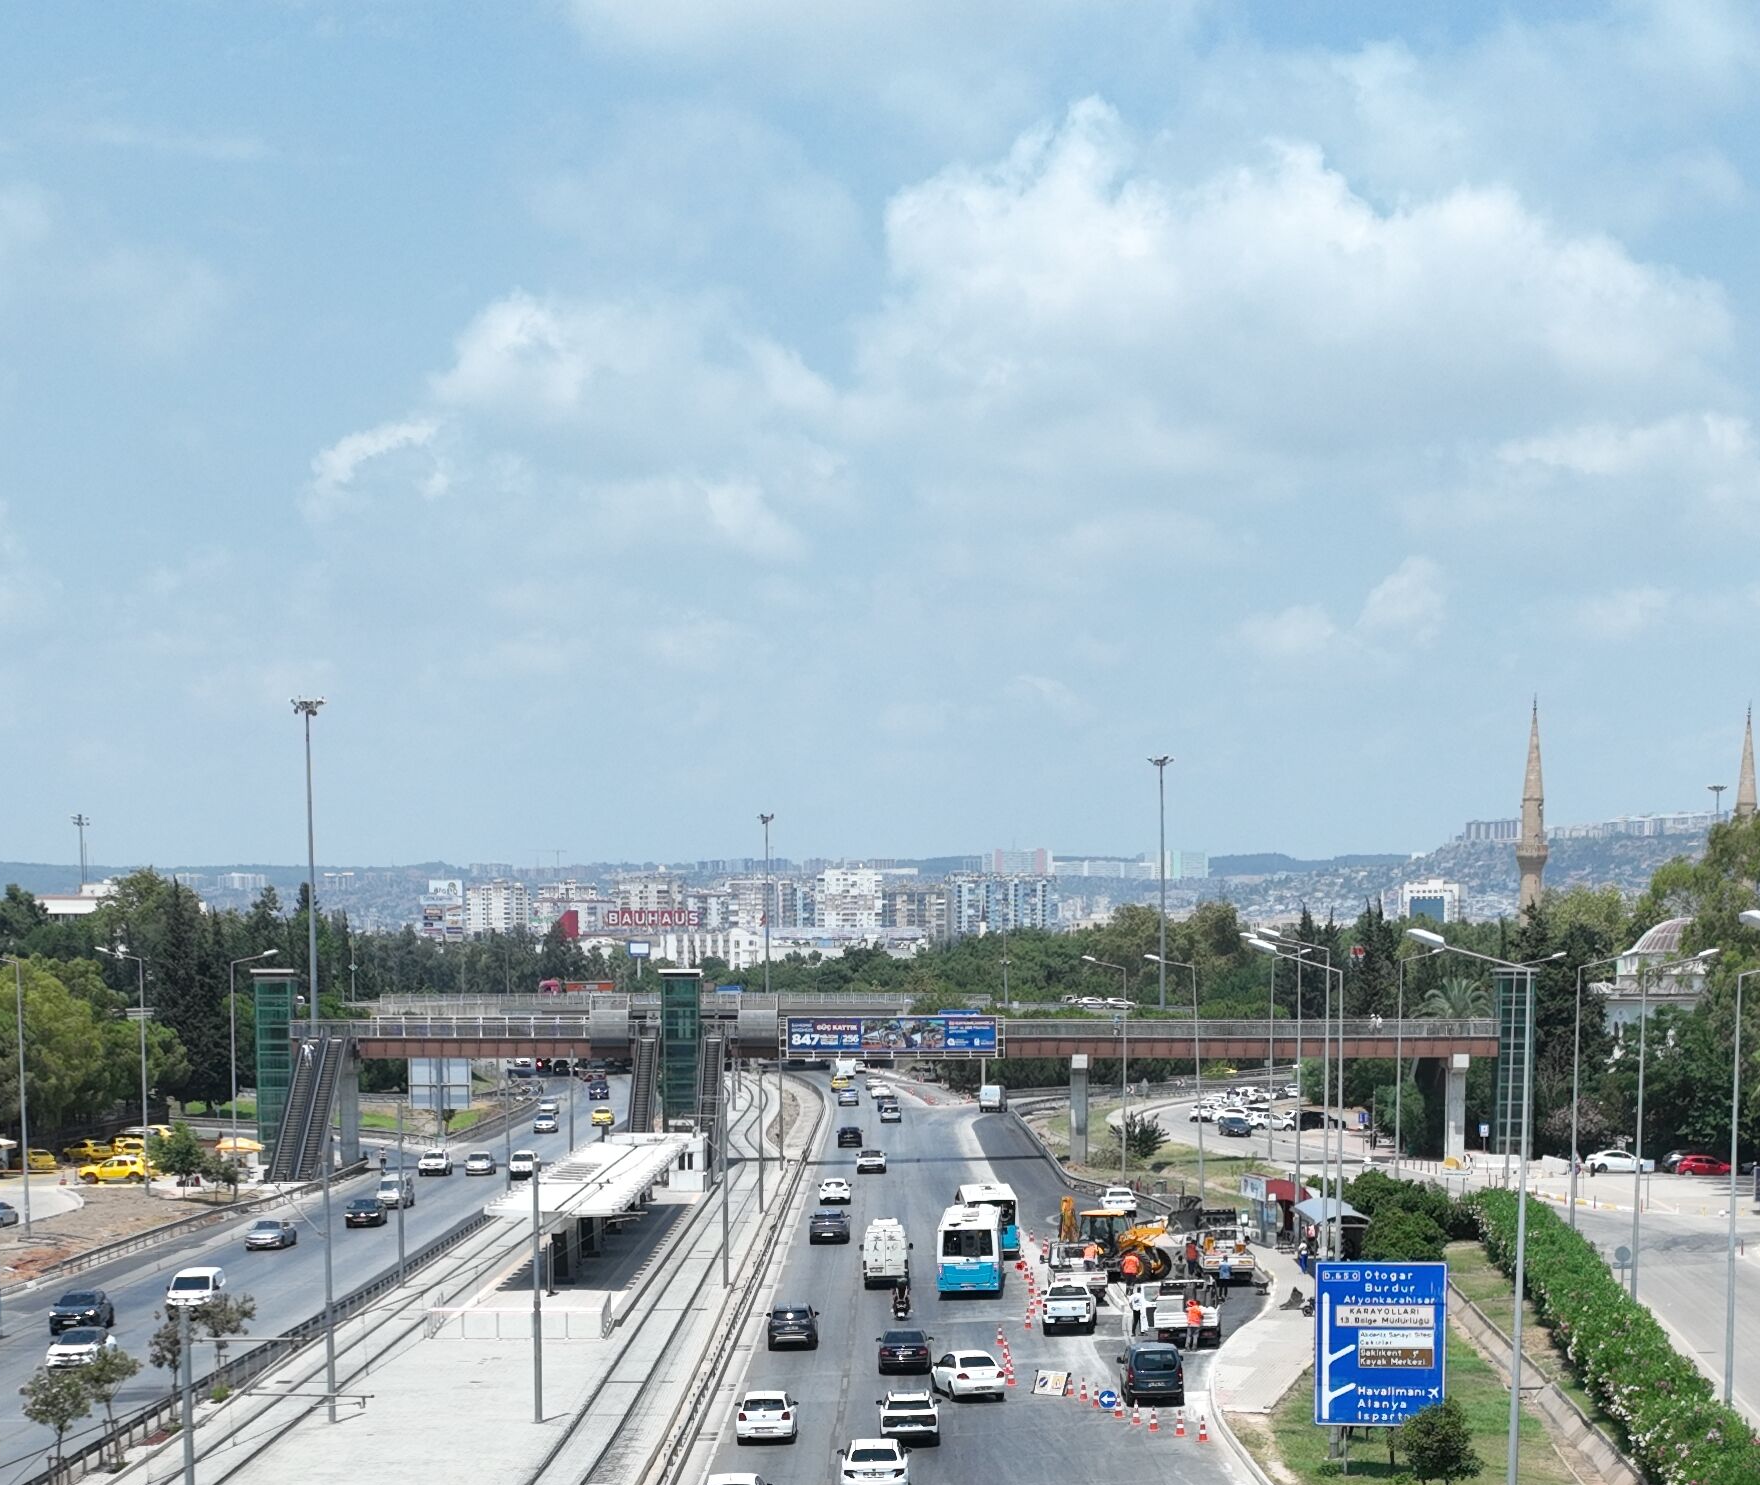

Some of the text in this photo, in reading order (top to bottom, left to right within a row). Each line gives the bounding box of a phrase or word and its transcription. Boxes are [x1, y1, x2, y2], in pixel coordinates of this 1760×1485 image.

[608, 912, 699, 924] BAUHAUS
[792, 1034, 820, 1045] 847
[1364, 1270, 1413, 1282] Otogar
[1365, 1283, 1415, 1292] Burdur
[1343, 1295, 1435, 1305] Afyonkarahisar
[1360, 1349, 1402, 1358] Saklıkent
[1360, 1358, 1426, 1367] Kayak Merkezi
[1357, 1386, 1425, 1396] Havalimanı
[1357, 1399, 1407, 1410] Alanya
